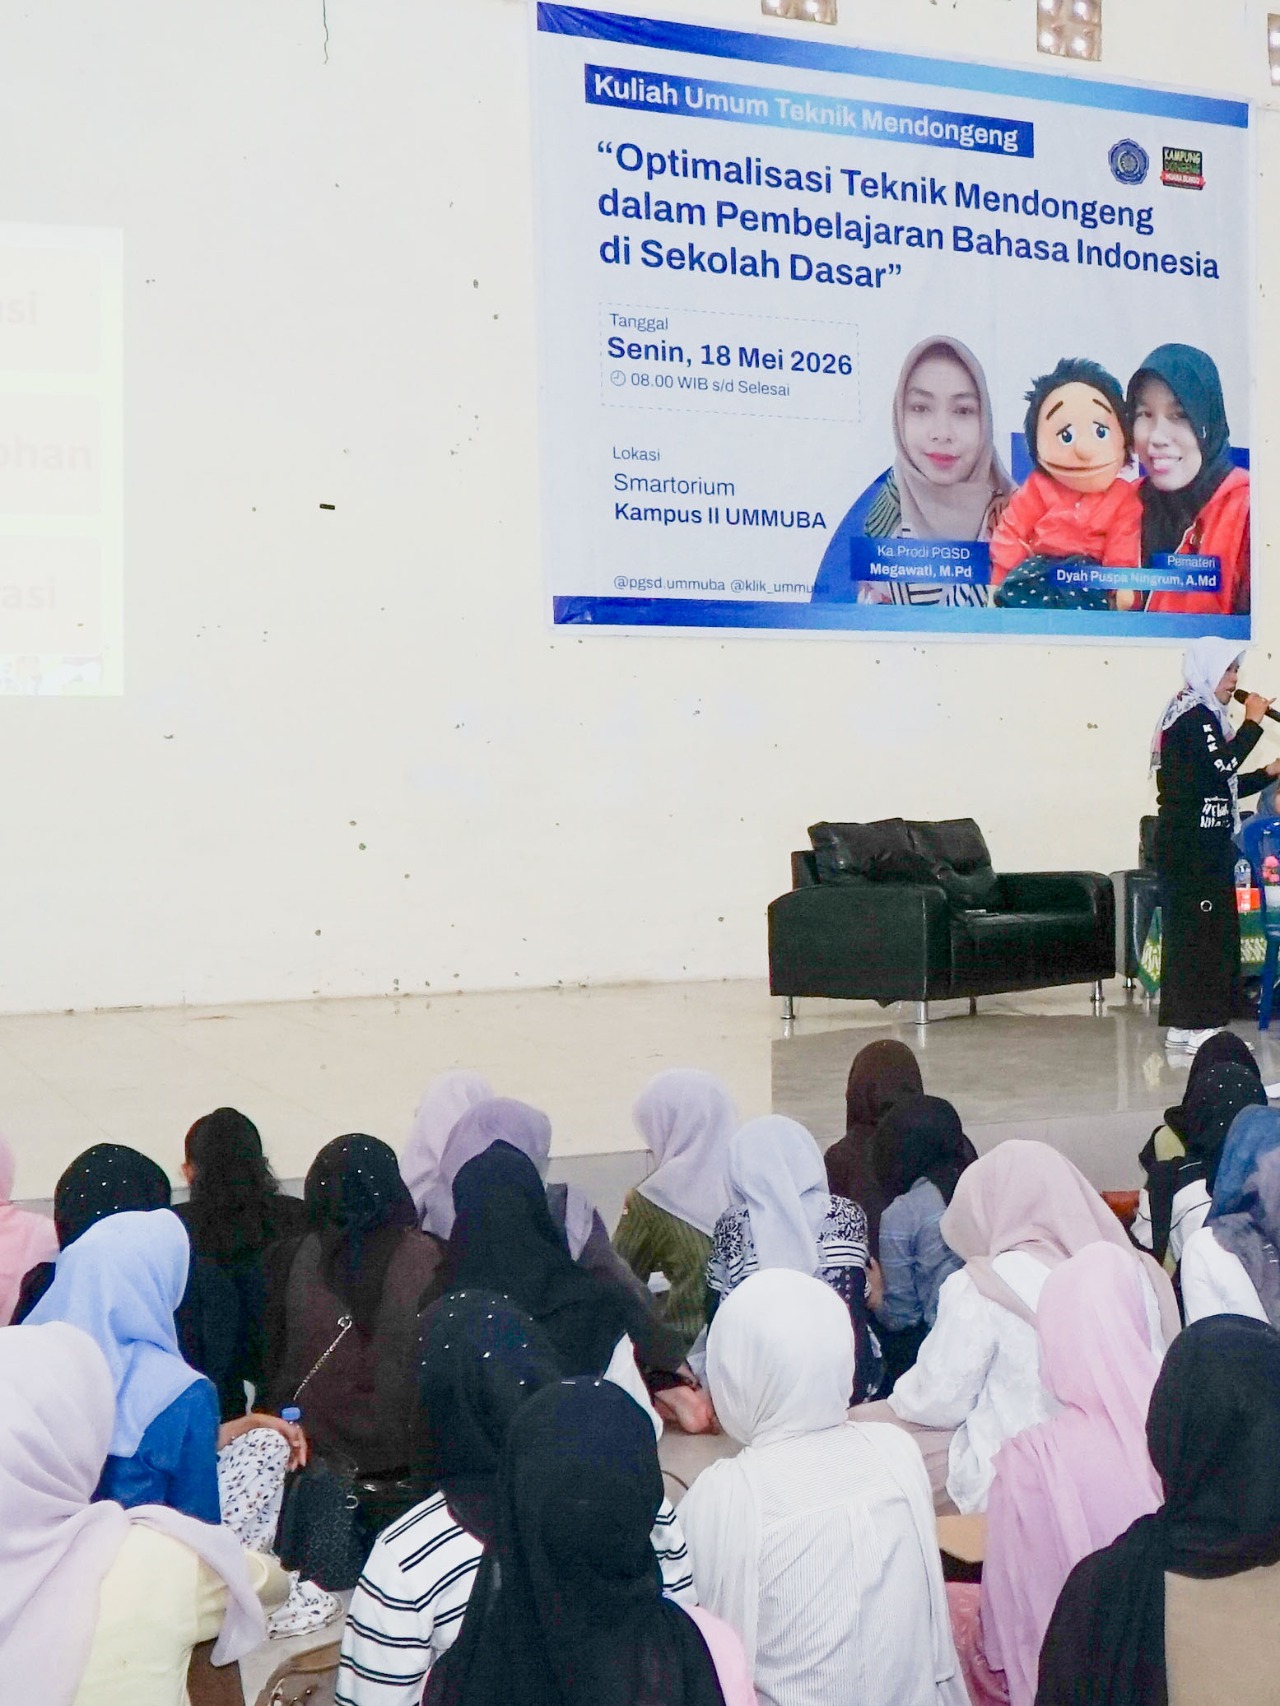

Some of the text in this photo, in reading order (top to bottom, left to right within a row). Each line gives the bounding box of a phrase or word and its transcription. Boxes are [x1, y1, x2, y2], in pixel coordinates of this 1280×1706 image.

[594, 73, 1018, 152] Kuliah Umum Teknik Mendongeng
[597, 141, 1155, 236] “Optimalisasi Teknik Mendongeng
[598, 187, 1220, 281] dalam Pembelajaran Bahasa Indonesia
[599, 235, 903, 289] di Sekolah Dasar”
[609, 312, 669, 333] Tanggal
[607, 336, 853, 376] Senin, 18 Mei 2026
[631, 372, 791, 397] 08.00 WIB s/d Selesai
[612, 446, 662, 462] Lokasi
[613, 472, 736, 497] Smartorium
[614, 502, 827, 530] Kampus II UMMUBA
[931, 547, 971, 560] PGSD
[1167, 555, 1217, 569] Pemateri
[870, 562, 973, 579] Megawati, M.Pd
[1056, 569, 1218, 588] Dyah Puspa Ningrum, A.Md
[613, 575, 726, 593] @pgsd.ummuba
[1202, 723, 1219, 753] KAK
